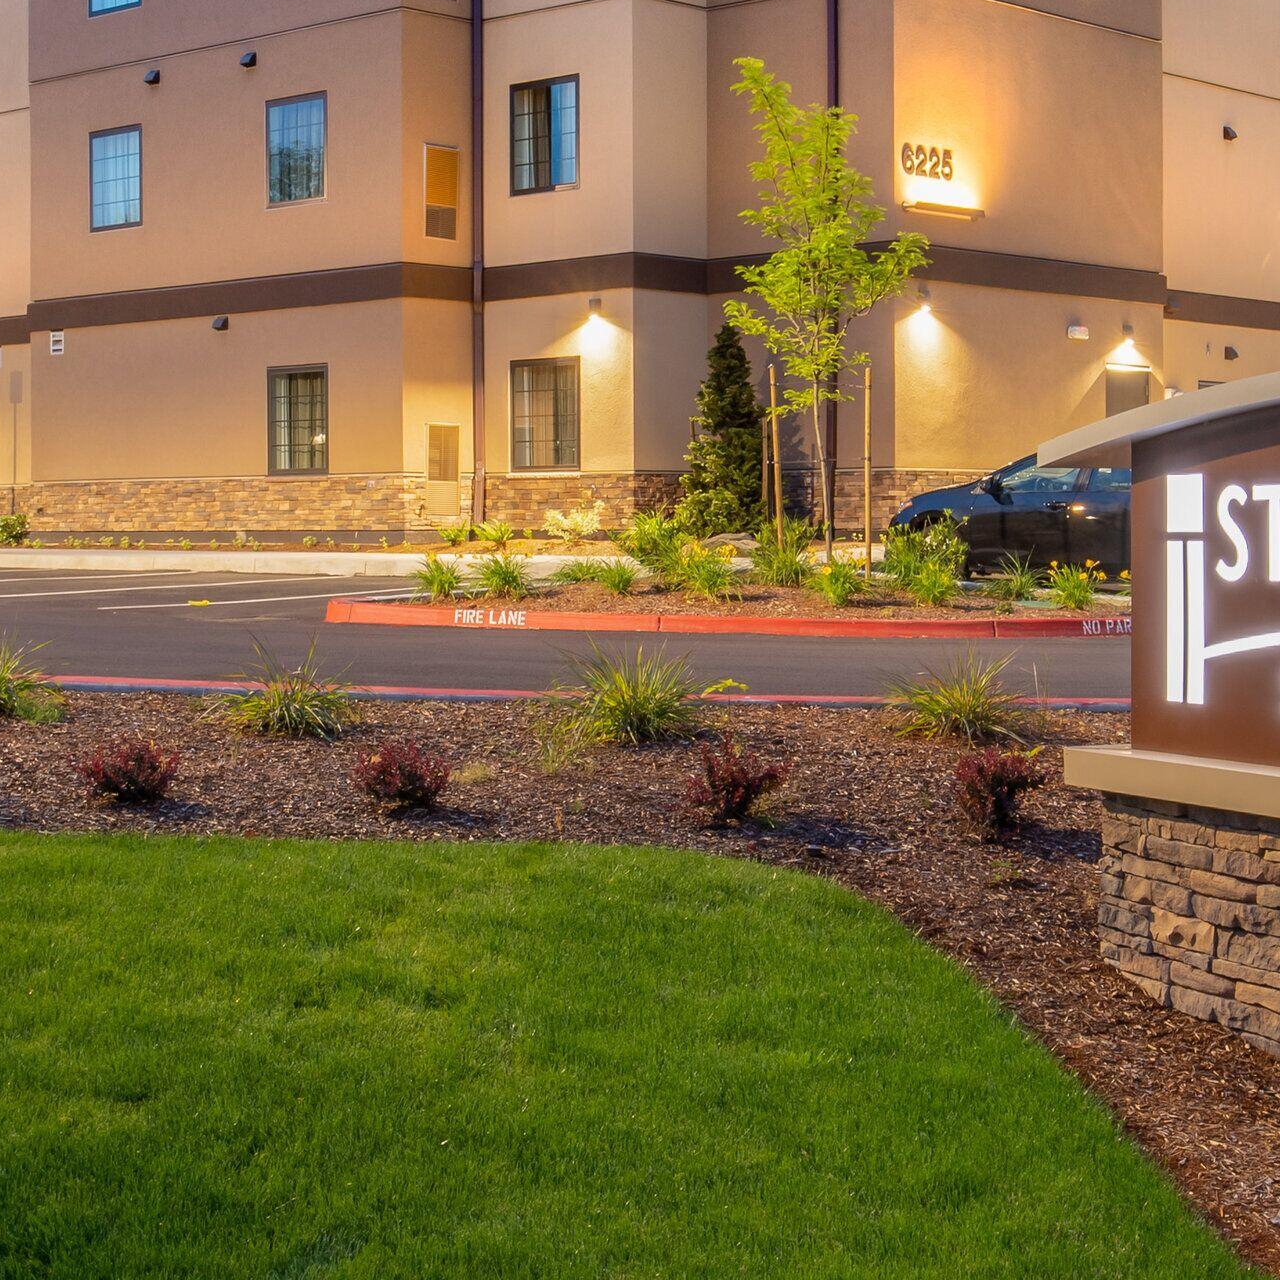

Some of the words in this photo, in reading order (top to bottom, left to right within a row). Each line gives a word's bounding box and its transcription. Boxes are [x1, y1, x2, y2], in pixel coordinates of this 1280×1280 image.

[901, 142, 953, 181] 6225
[454, 609, 484, 625] FIRE
[488, 609, 527, 626] LANE
[1082, 619, 1101, 635] NO
